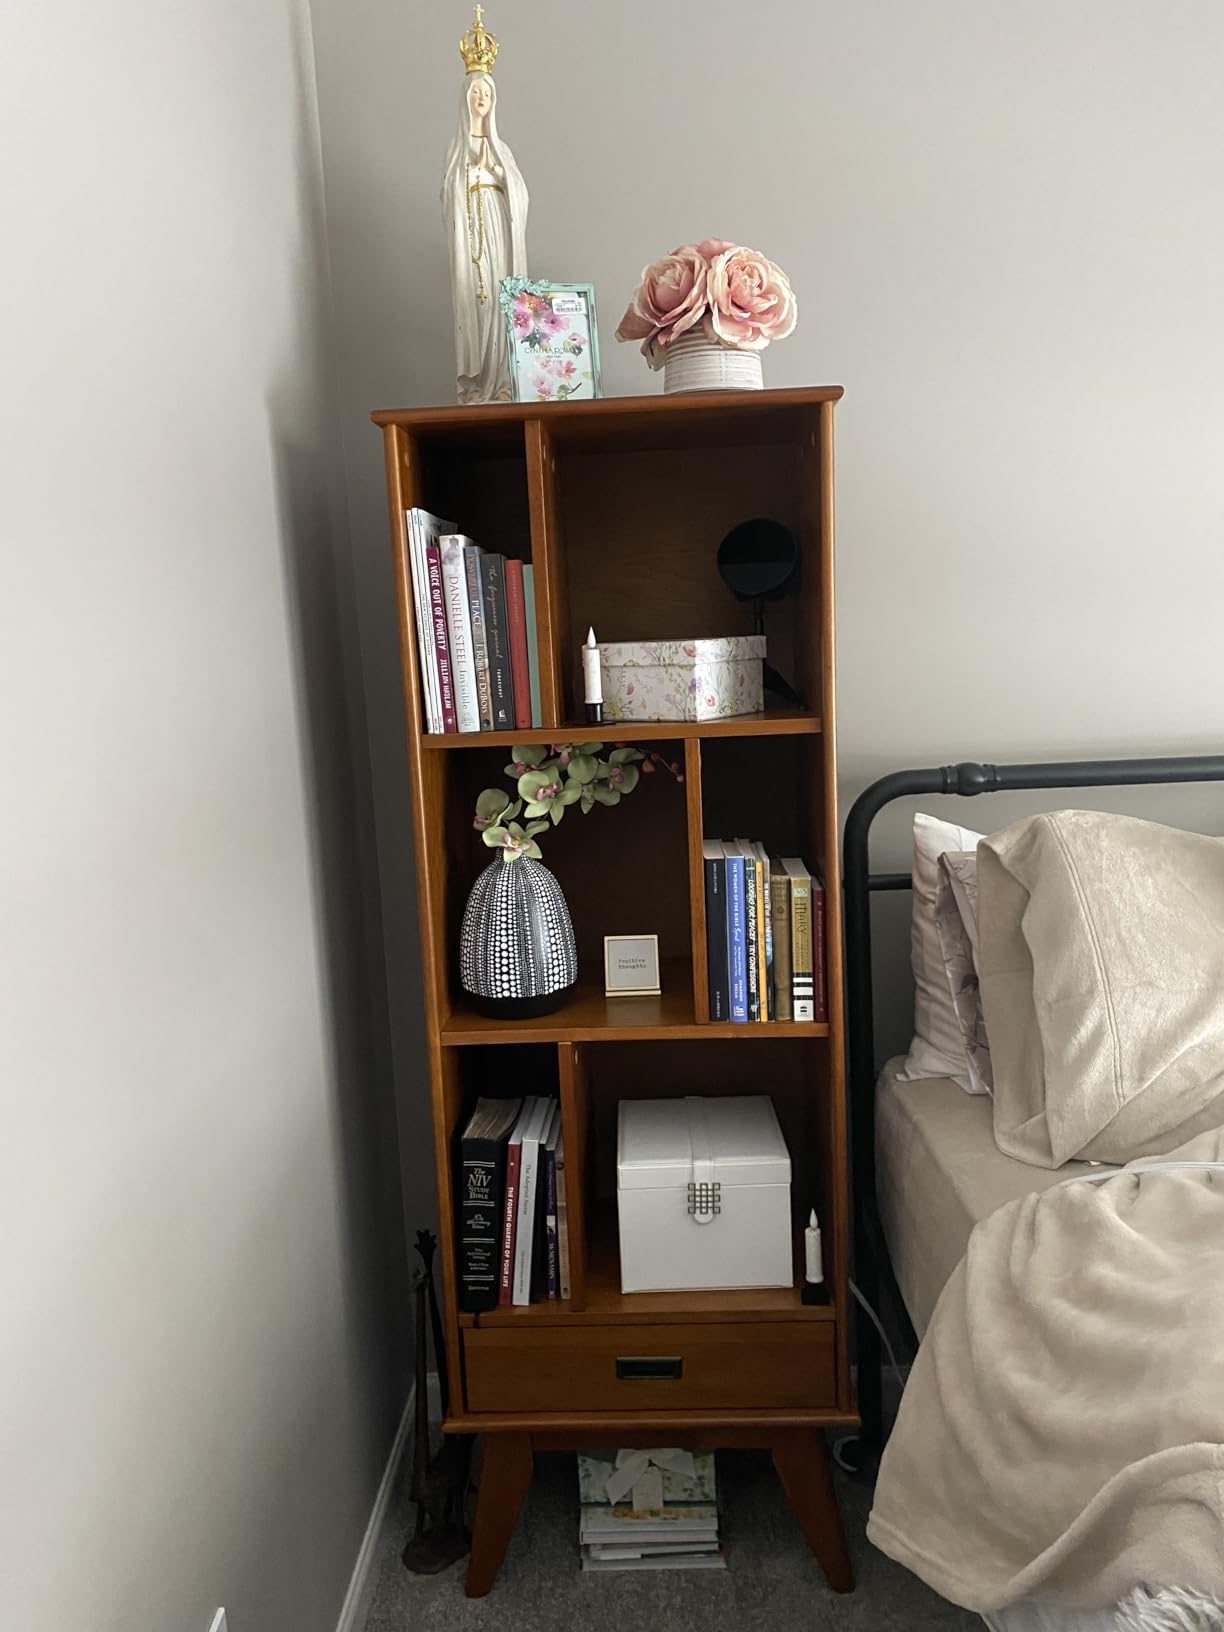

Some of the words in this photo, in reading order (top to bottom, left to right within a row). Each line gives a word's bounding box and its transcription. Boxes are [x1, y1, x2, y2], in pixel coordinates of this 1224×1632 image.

[430, 565, 440, 587] VOICE
[467, 553, 479, 600] POWERFUL
[432, 589, 442, 604] OUT
[448, 576, 461, 632] DANIELLE
[434, 606, 443, 617] OF
[470, 600, 481, 627] PEACE
[435, 618, 447, 650] POVERTY
[454, 633, 466, 666] STEEL
[440, 658, 451, 683] JILLIAN
[475, 650, 486, 681] ROBERT
[443, 685, 452, 709] HASLAM
[459, 670, 470, 709] Invisible
[747, 879, 755, 904] LOOKING
[748, 905, 756, 917] FOR
[795, 902, 807, 935] MARY
[467, 1174, 492, 1187] NIV
[504, 1249, 511, 1259] OF
